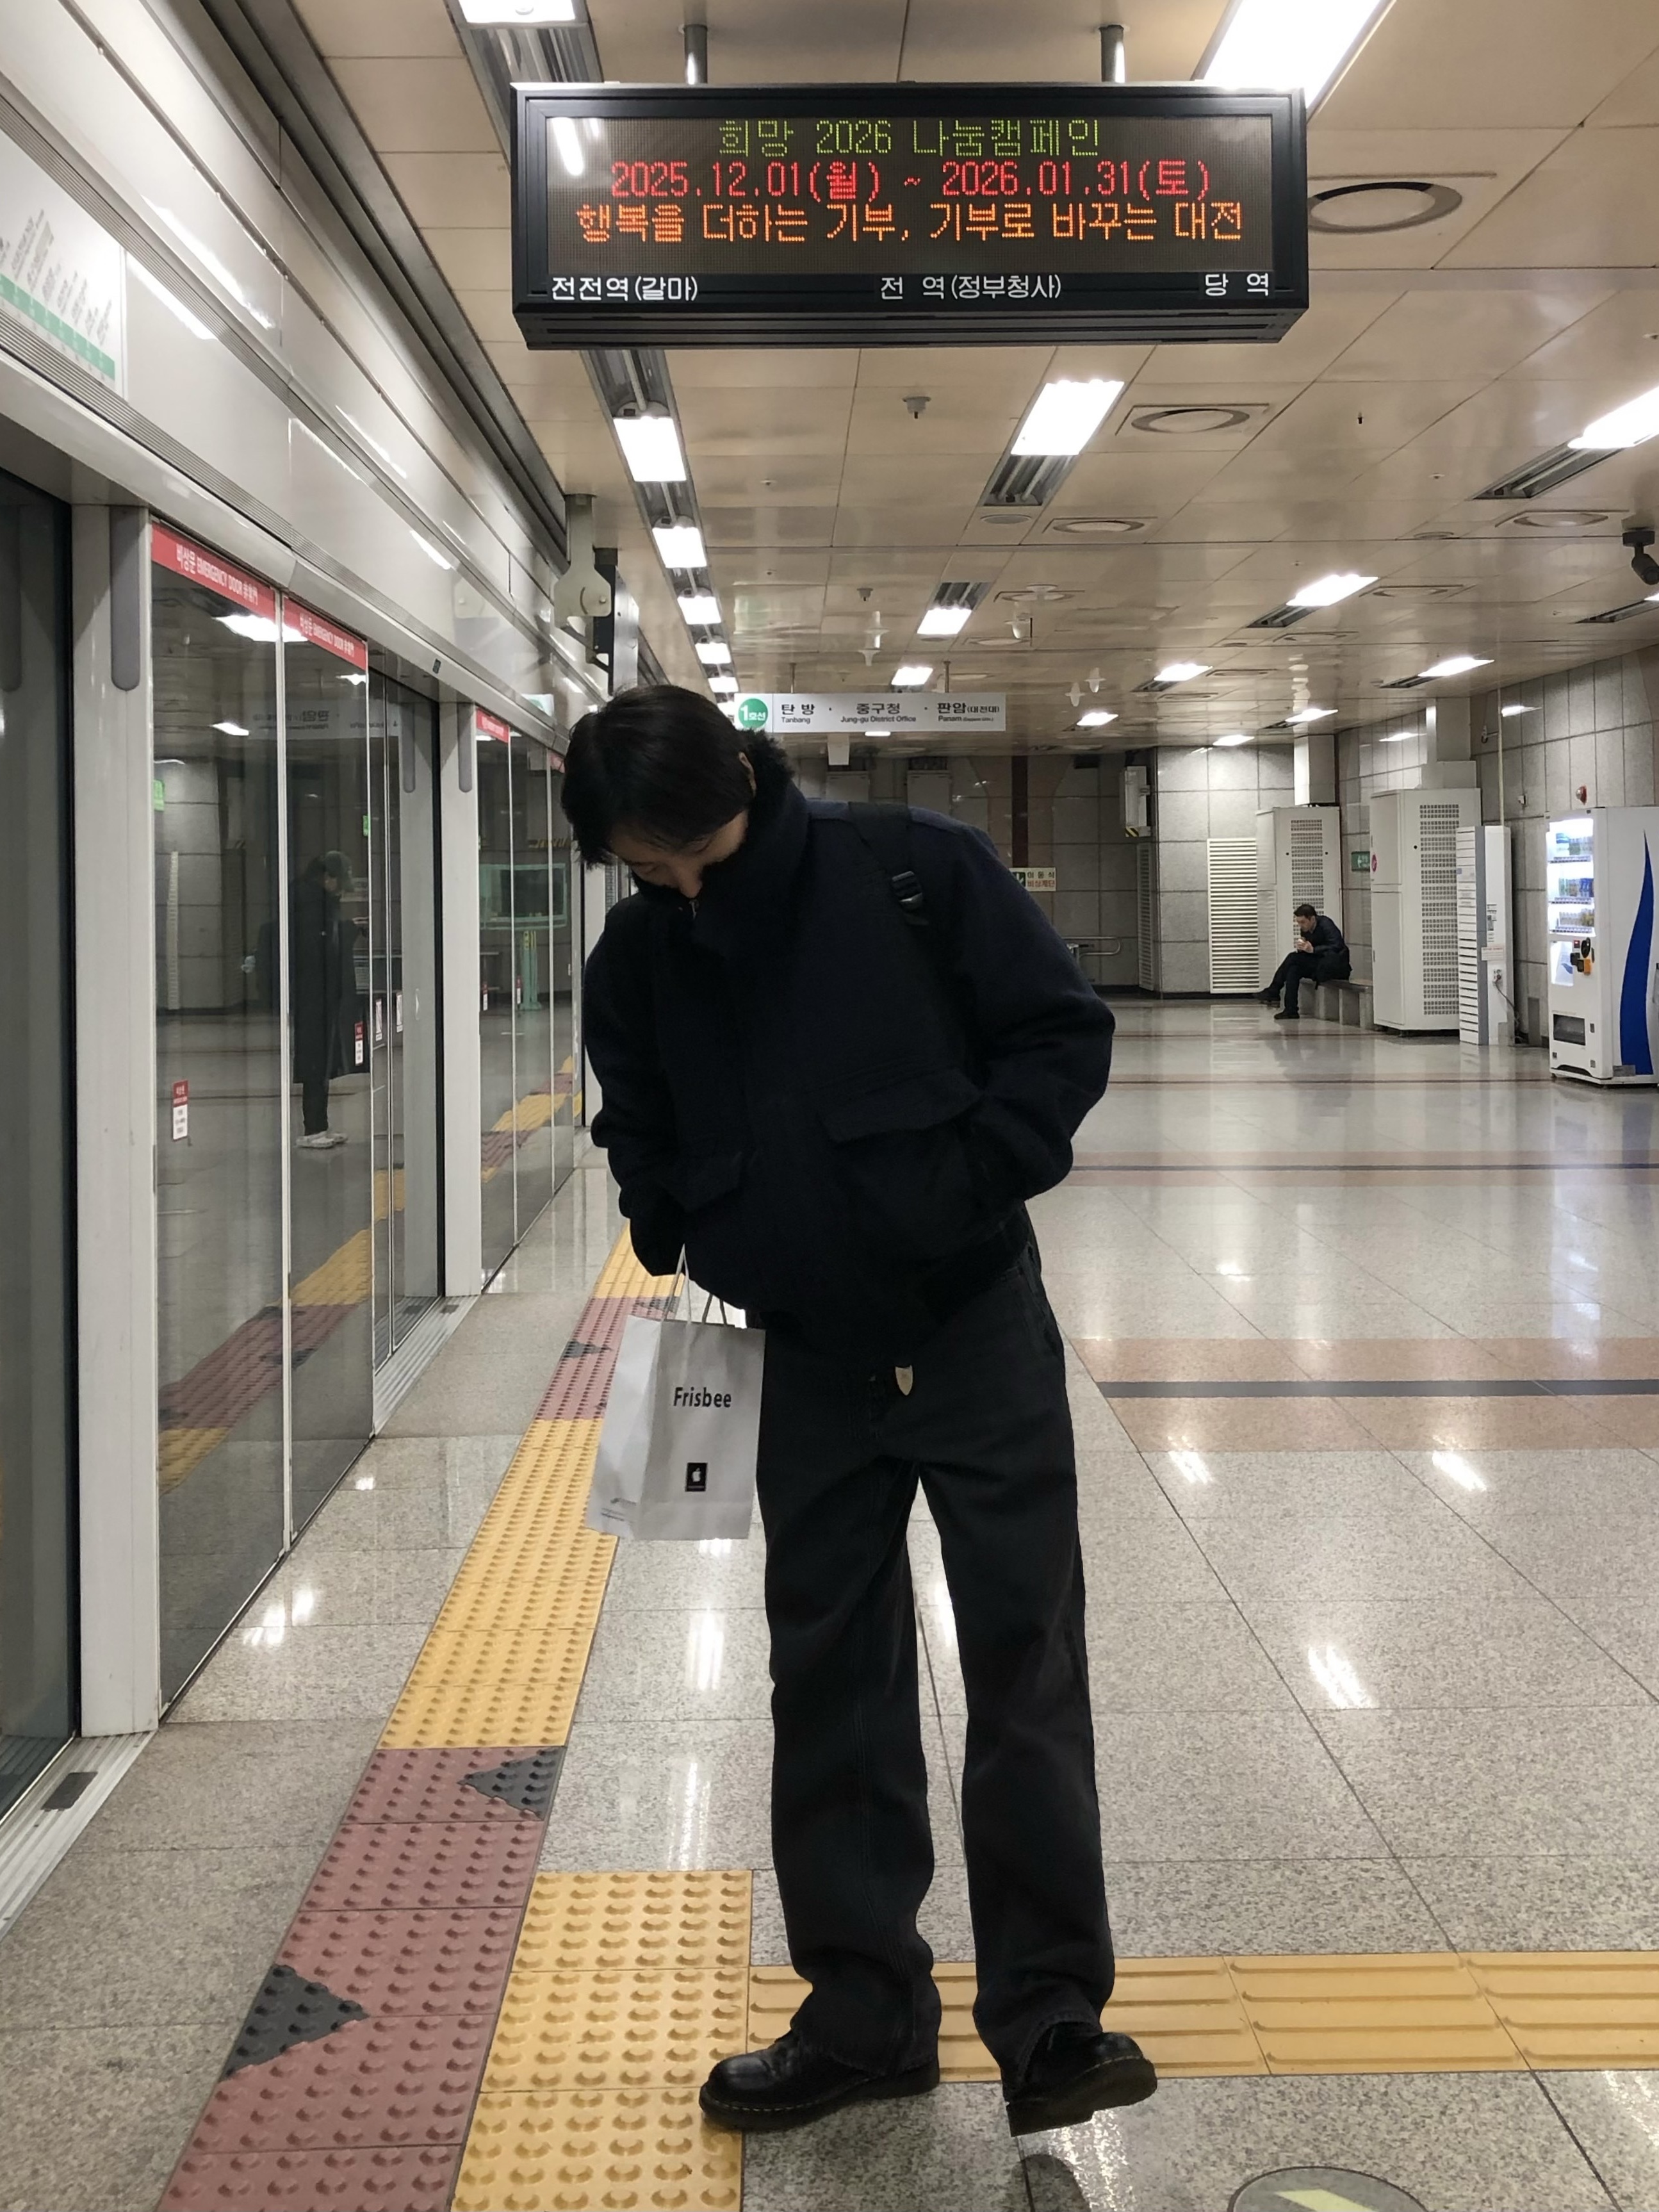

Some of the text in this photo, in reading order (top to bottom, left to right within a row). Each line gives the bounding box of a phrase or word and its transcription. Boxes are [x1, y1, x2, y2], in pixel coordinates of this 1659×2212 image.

[719, 119, 1099, 157] 희망 2026 나눔캠페인
[610, 161, 880, 202] 2025.12.01(월)
[942, 160, 1209, 201] 2026.01.31(토)
[576, 202, 1241, 242] 행복을 더하는 기부, 기부로 바꾸는 대전
[552, 275, 698, 302] 전전역(갈마)
[740, 705, 766, 721] 1호선
[781, 716, 811, 725] Tanbang
[856, 703, 901, 714] 중구청
[673, 1386, 732, 1408] Frisbee
